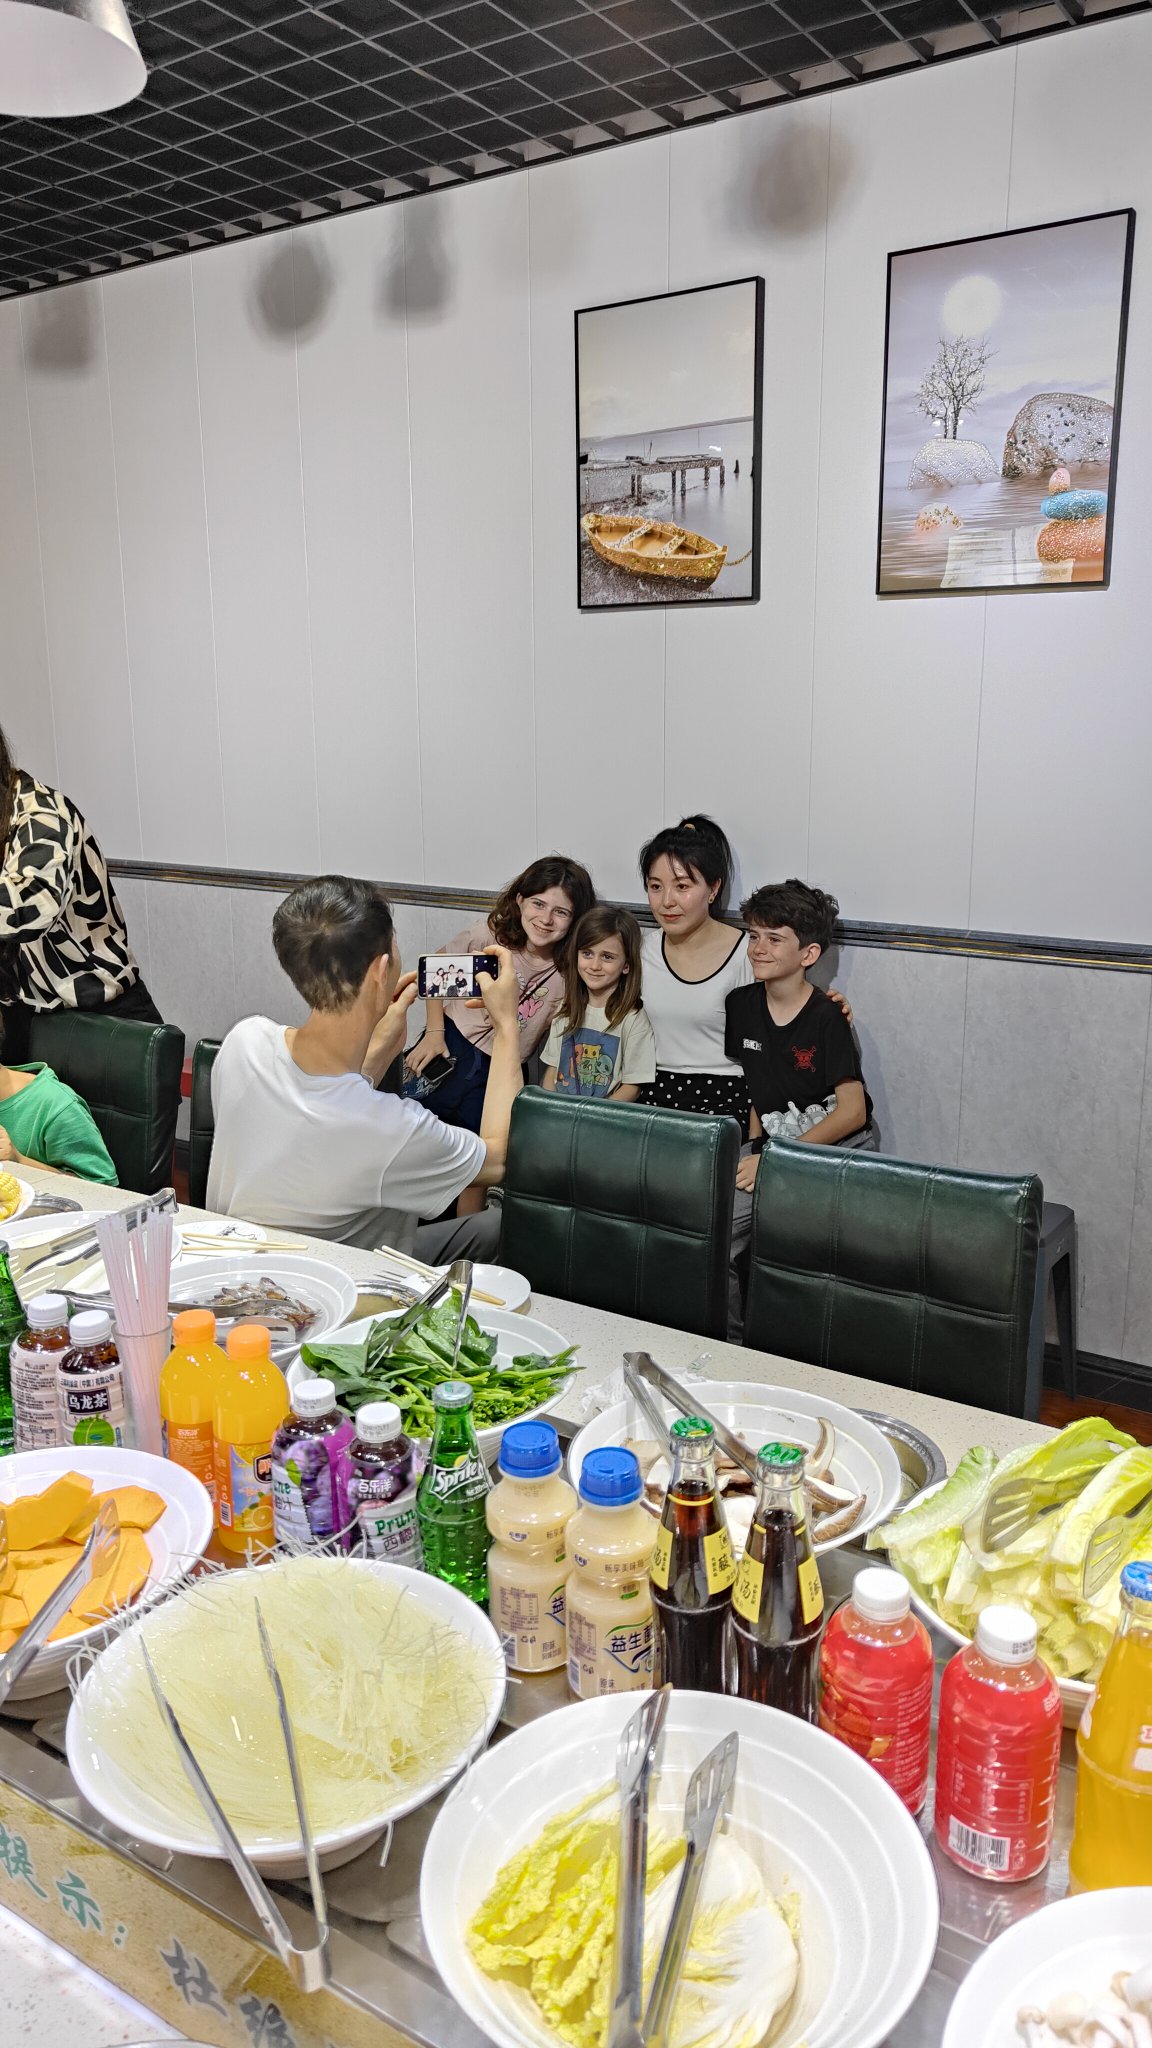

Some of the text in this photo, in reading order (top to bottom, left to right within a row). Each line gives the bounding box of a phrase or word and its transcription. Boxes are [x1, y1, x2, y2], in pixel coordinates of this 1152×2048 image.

[69, 1392, 108, 1410] 乌龙茶
[433, 1460, 478, 1494] Sprite
